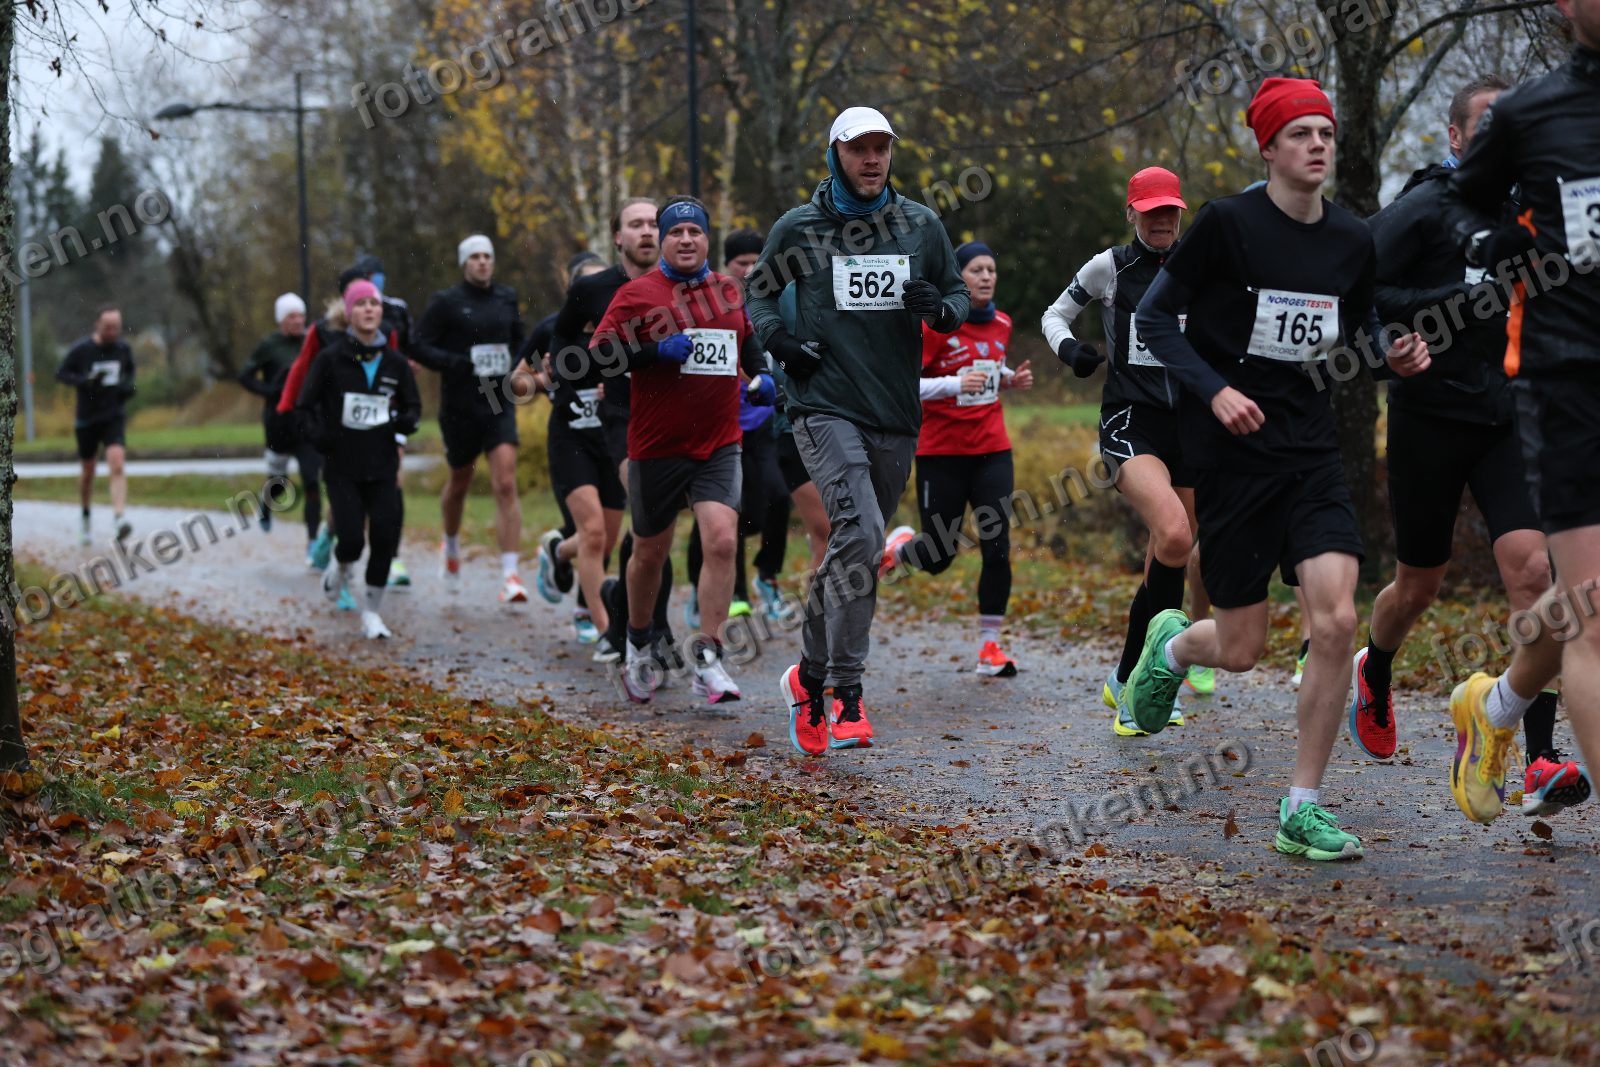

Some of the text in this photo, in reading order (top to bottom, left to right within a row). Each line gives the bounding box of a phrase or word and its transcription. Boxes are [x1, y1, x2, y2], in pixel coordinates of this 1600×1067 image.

[848, 270, 895, 299] 562
[1267, 295, 1334, 309] NORGESTESTEN
[1276, 311, 1324, 346] 165
[694, 342, 728, 365] 824
[352, 404, 378, 421] 671
